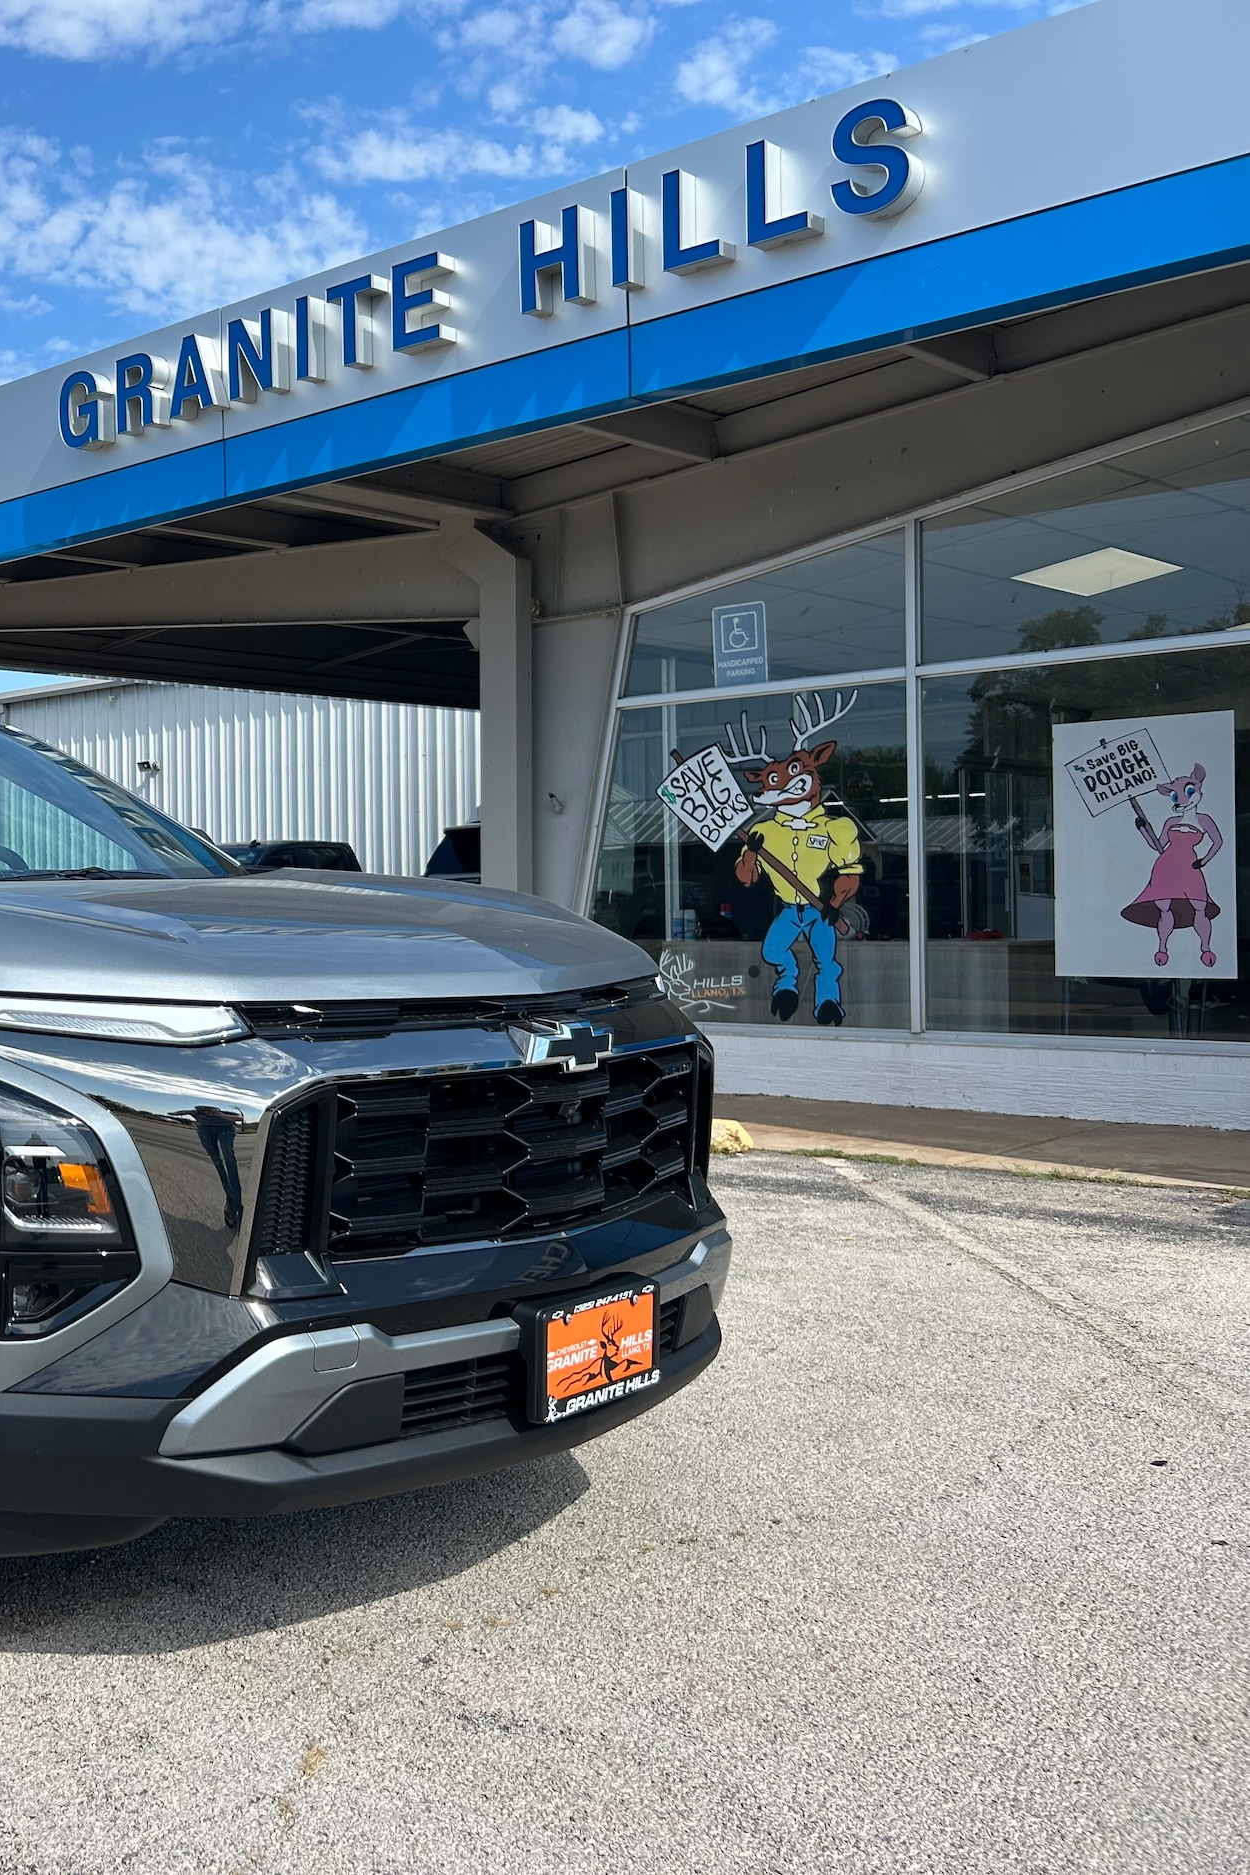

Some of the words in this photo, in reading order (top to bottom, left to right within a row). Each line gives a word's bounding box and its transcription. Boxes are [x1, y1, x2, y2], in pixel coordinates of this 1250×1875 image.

[59, 252, 452, 450] GRANITE
[520, 98, 922, 317] HILLS
[717, 656, 764, 669] HANDICAPPED
[726, 667, 756, 678] PARKING
[1083, 750, 1150, 792] DOUGH
[1086, 752, 1116, 770] Save
[1117, 739, 1139, 756] BIG
[670, 751, 723, 798] SAVE
[1094, 791, 1109, 803] in
[1108, 767, 1157, 796] LLANO!
[680, 776, 730, 823] BIG
[700, 794, 749, 843] BUCKS
[691, 987, 729, 999] LLANO,
[730, 986, 745, 996] TX
[693, 975, 743, 989] HILLS
[547, 1345, 598, 1373] GRANITE
[619, 1329, 653, 1350] HILLS
[556, 1340, 587, 1356] CHEVROLET
[566, 1381, 624, 1414] GRANITE
[625, 1369, 661, 1393] HILLS
